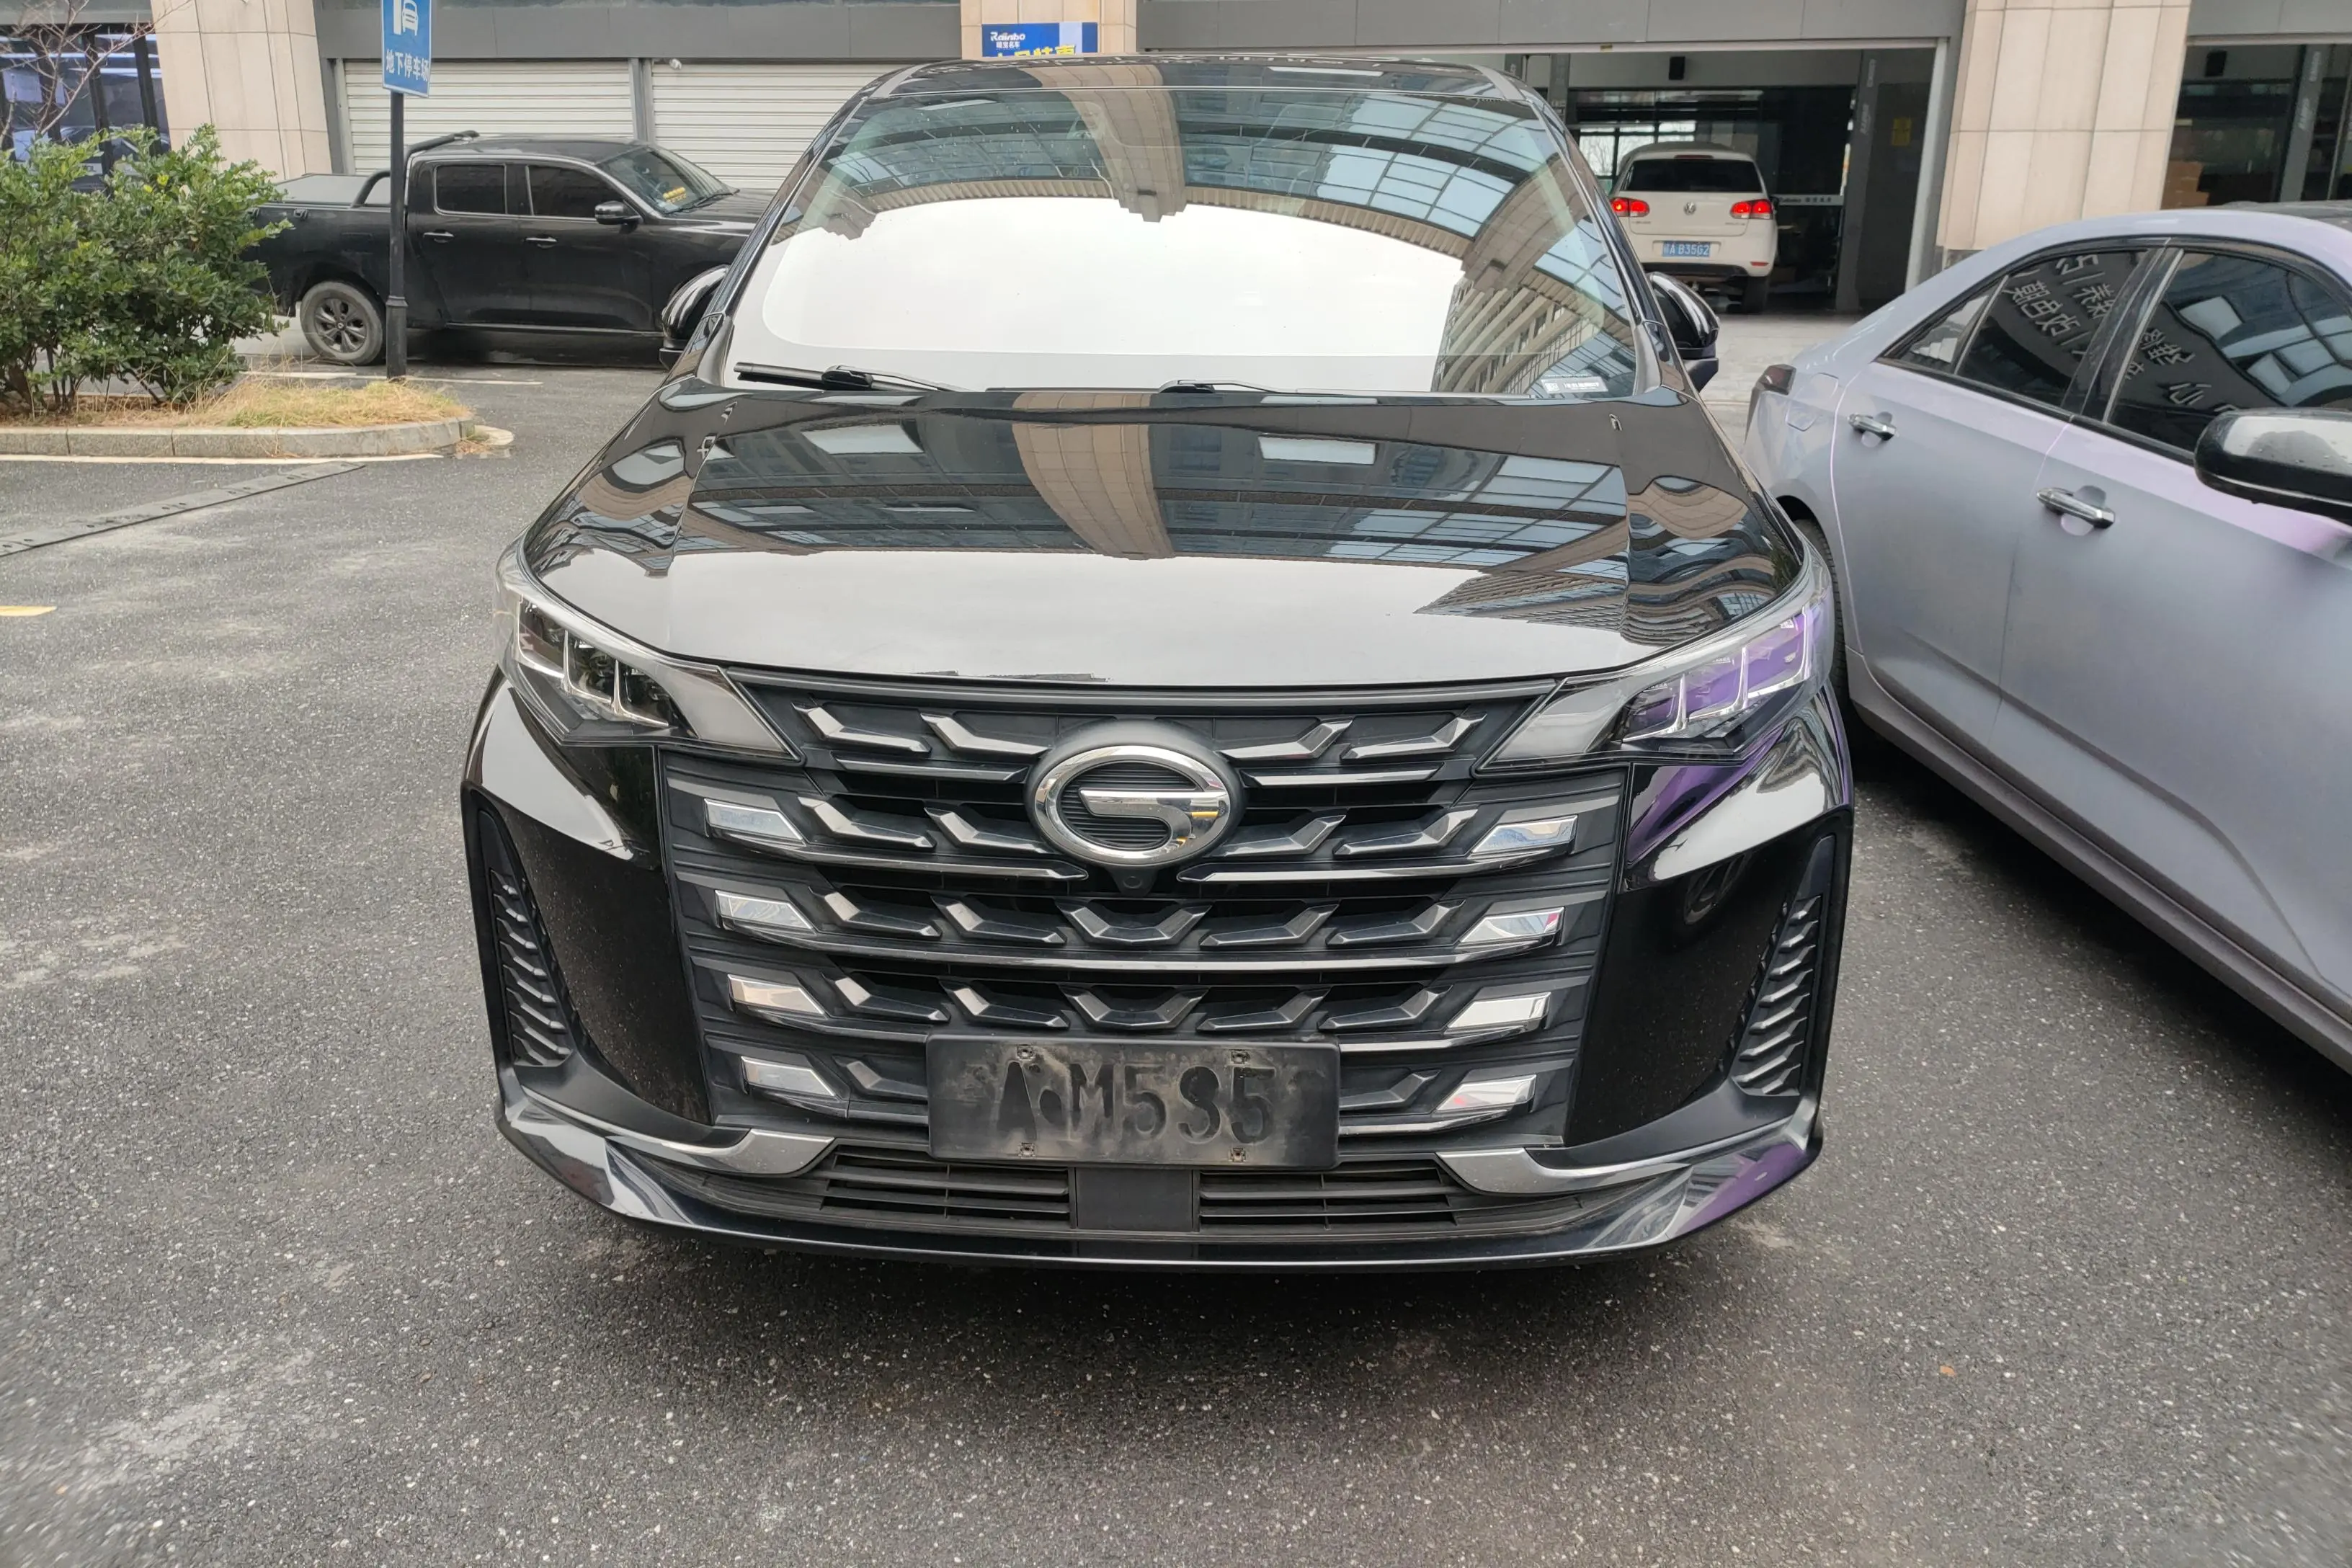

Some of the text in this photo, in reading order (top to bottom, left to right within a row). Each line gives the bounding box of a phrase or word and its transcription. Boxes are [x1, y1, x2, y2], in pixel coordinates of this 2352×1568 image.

[386, 48, 430, 81] 地下停车场
